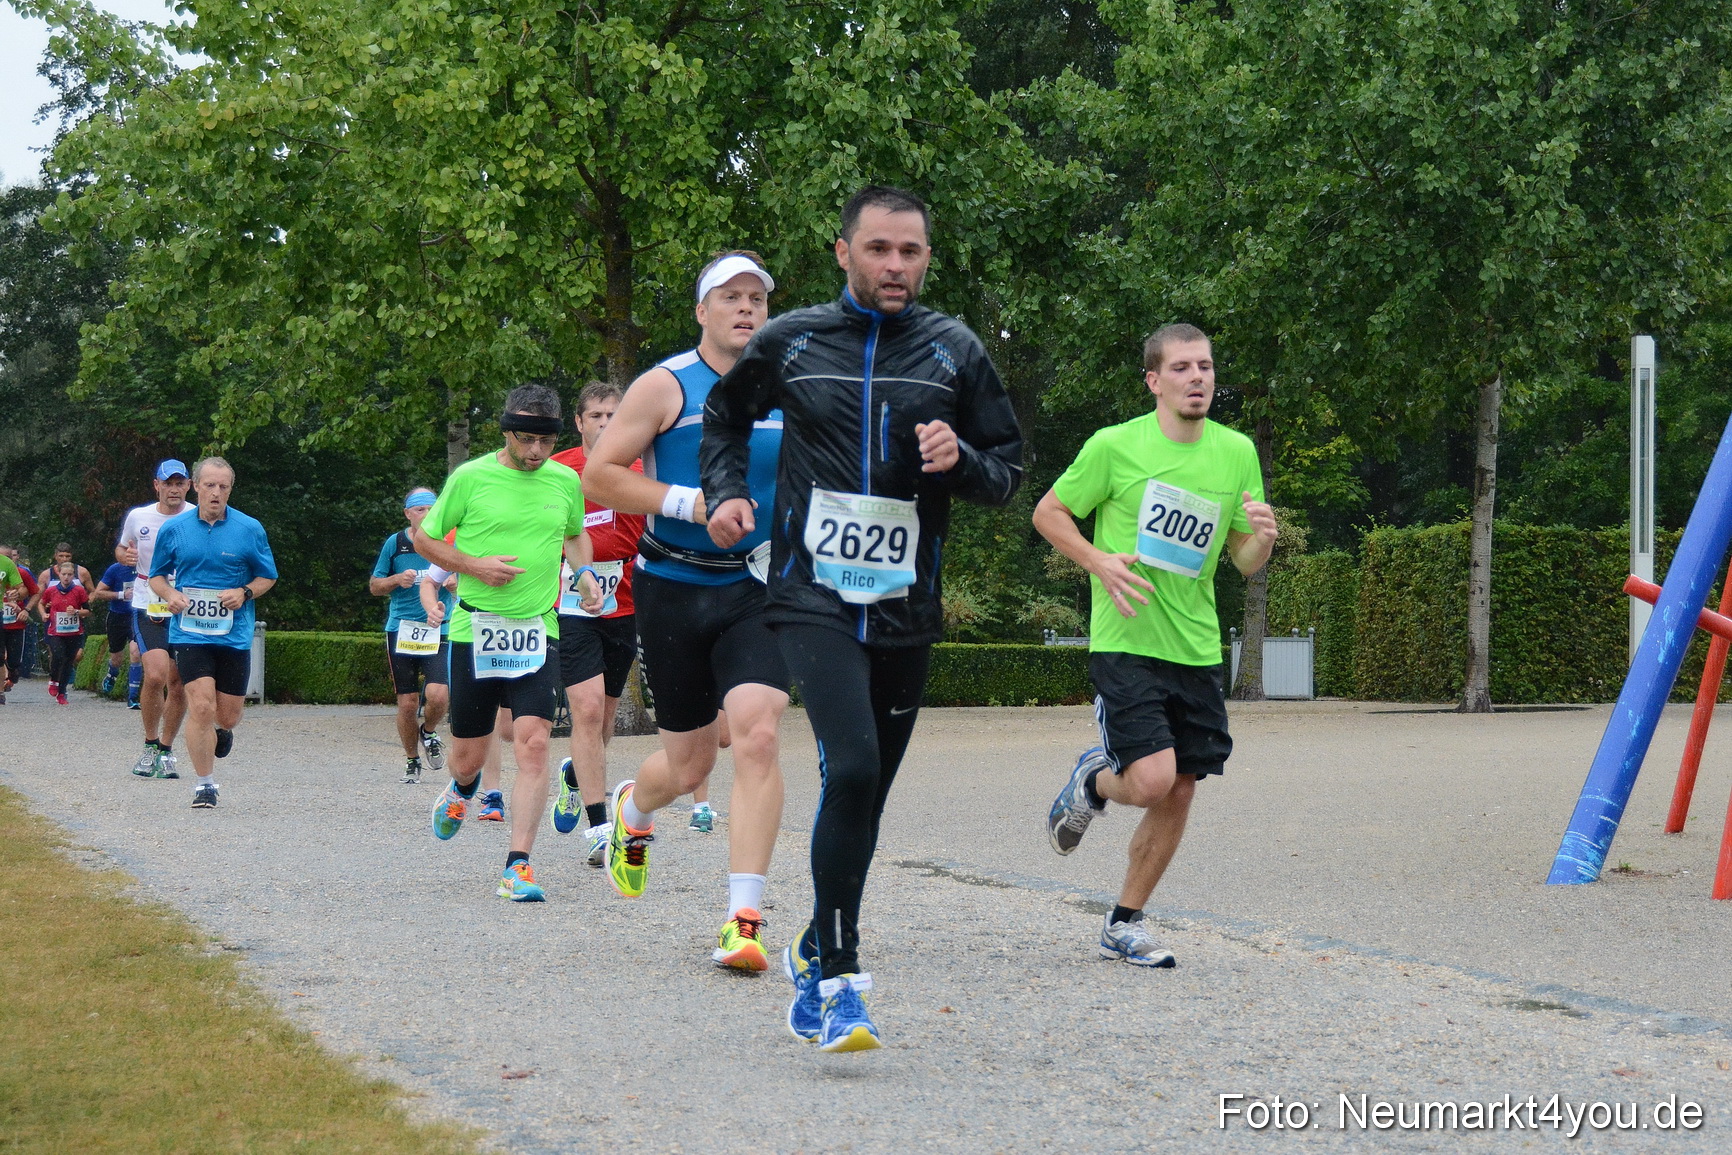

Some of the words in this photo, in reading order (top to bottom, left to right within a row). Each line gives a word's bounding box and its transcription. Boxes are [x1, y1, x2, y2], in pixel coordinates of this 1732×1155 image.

[586, 515, 604, 523] DEHN
[1145, 503, 1214, 548] 2008
[816, 518, 908, 564] 2629
[568, 575, 618, 595] 299
[841, 570, 875, 588] Rico
[187, 599, 229, 617] 2858
[59, 616, 78, 625] 2519
[195, 620, 219, 629] Markus
[411, 627, 429, 641] 87
[481, 628, 540, 652] 2306
[400, 642, 436, 650] Hans-Werner
[491, 657, 530, 668] Bernhard
